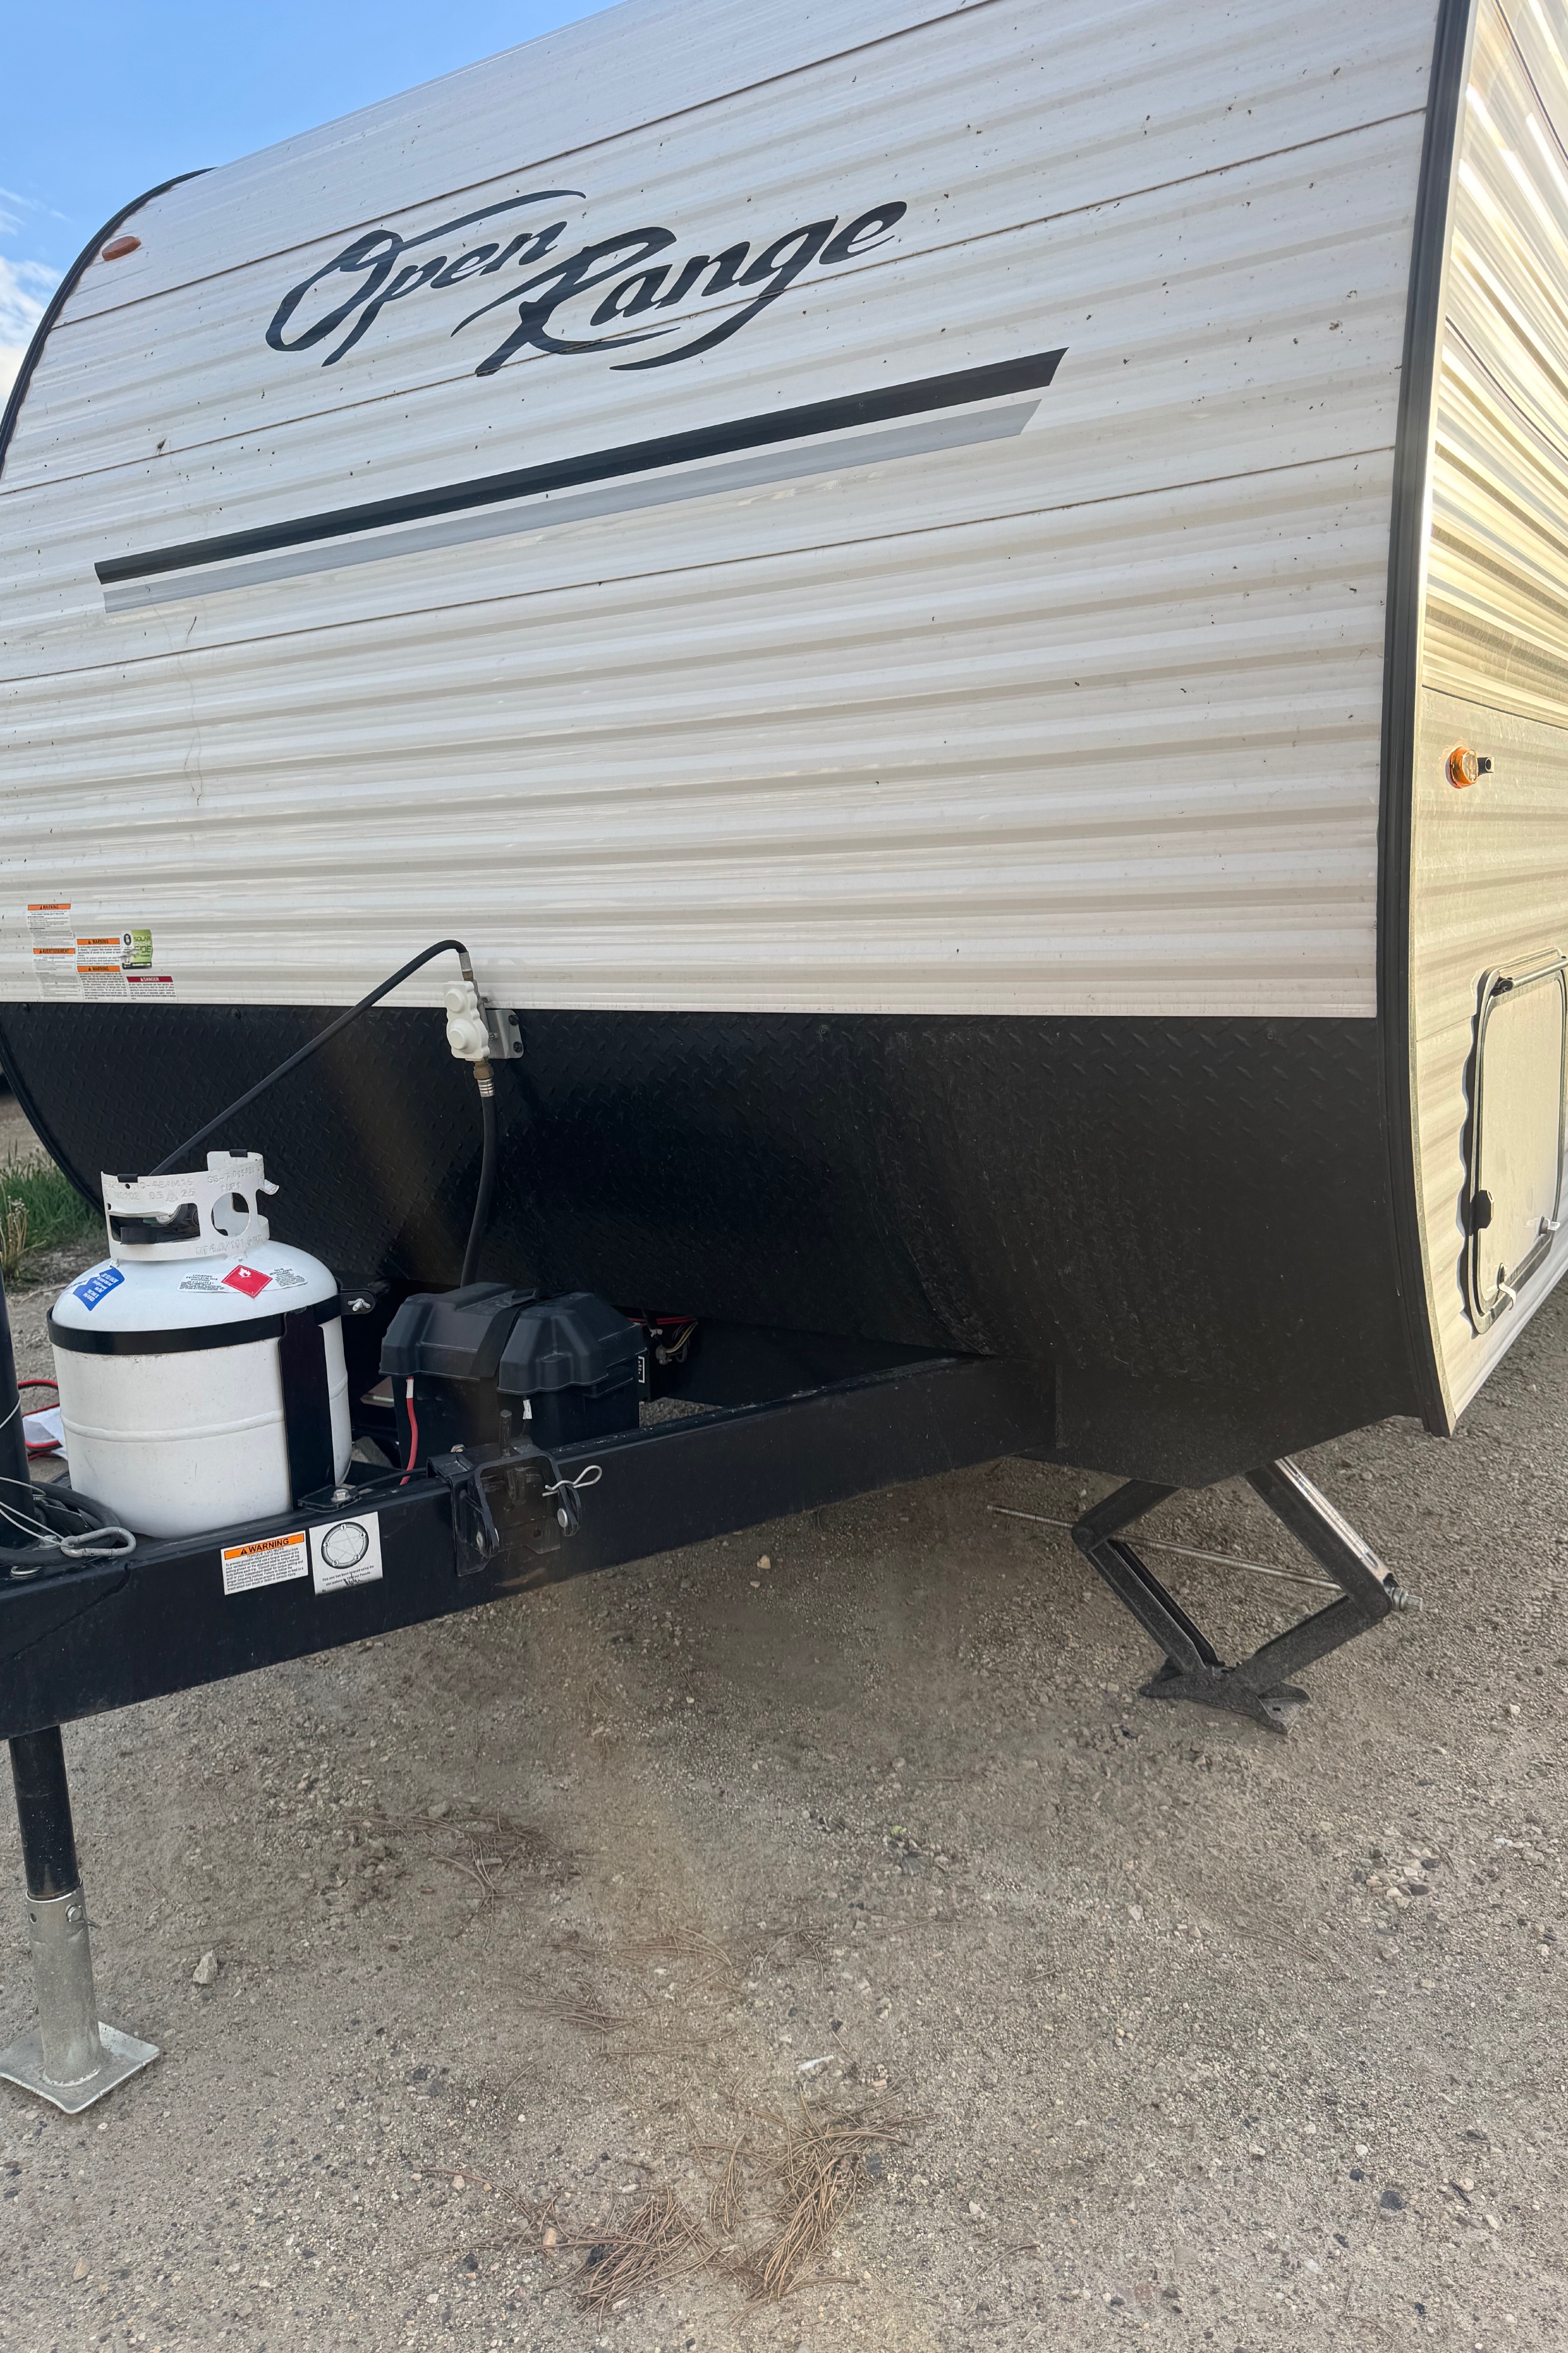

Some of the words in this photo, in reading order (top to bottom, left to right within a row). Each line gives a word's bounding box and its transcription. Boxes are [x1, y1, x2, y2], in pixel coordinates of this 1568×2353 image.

[265, 190, 586, 367] Open
[451, 201, 907, 377] Range
[249, 1538, 289, 1552] WARNING
